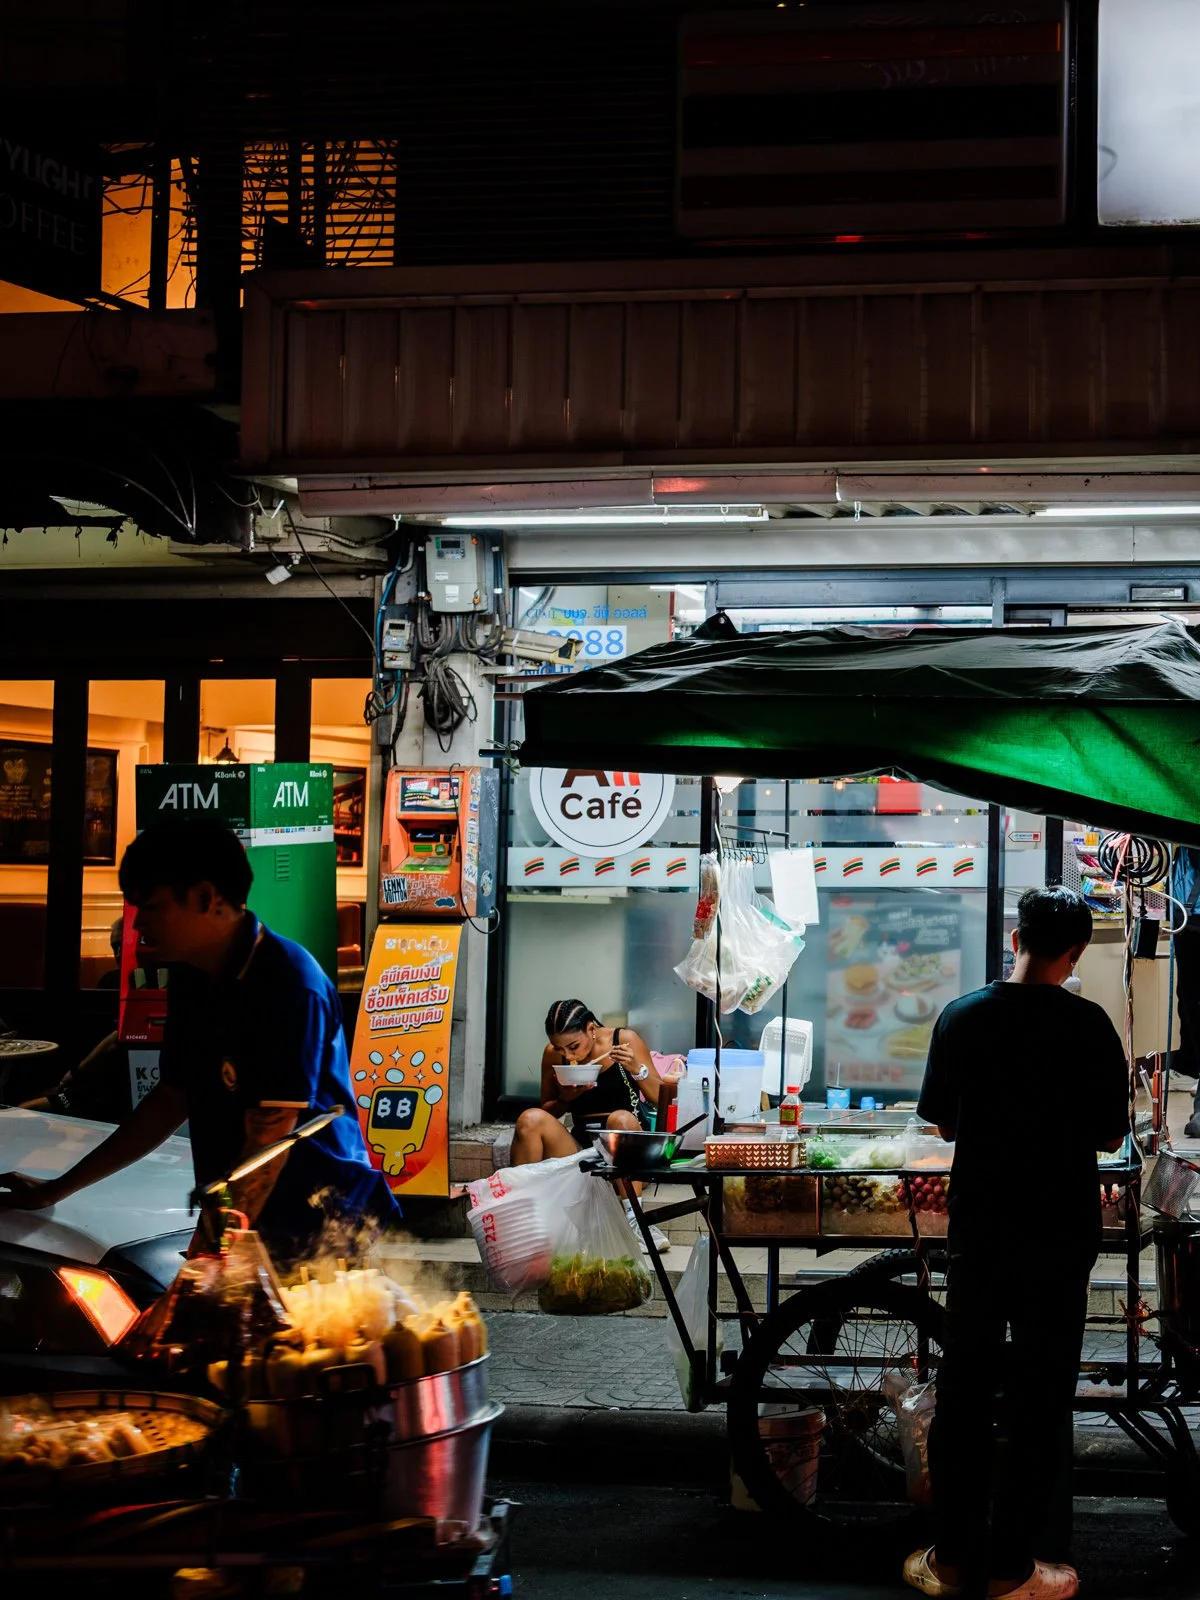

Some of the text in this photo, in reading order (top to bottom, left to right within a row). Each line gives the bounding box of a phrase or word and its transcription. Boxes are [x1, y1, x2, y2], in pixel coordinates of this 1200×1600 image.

[0, 137, 95, 201] YLIGHT
[214, 771, 236, 779] KBank
[158, 782, 219, 810] ATM
[272, 781, 309, 808] ATM
[560, 788, 642, 820] Café
[481, 1212, 498, 1244] 213
